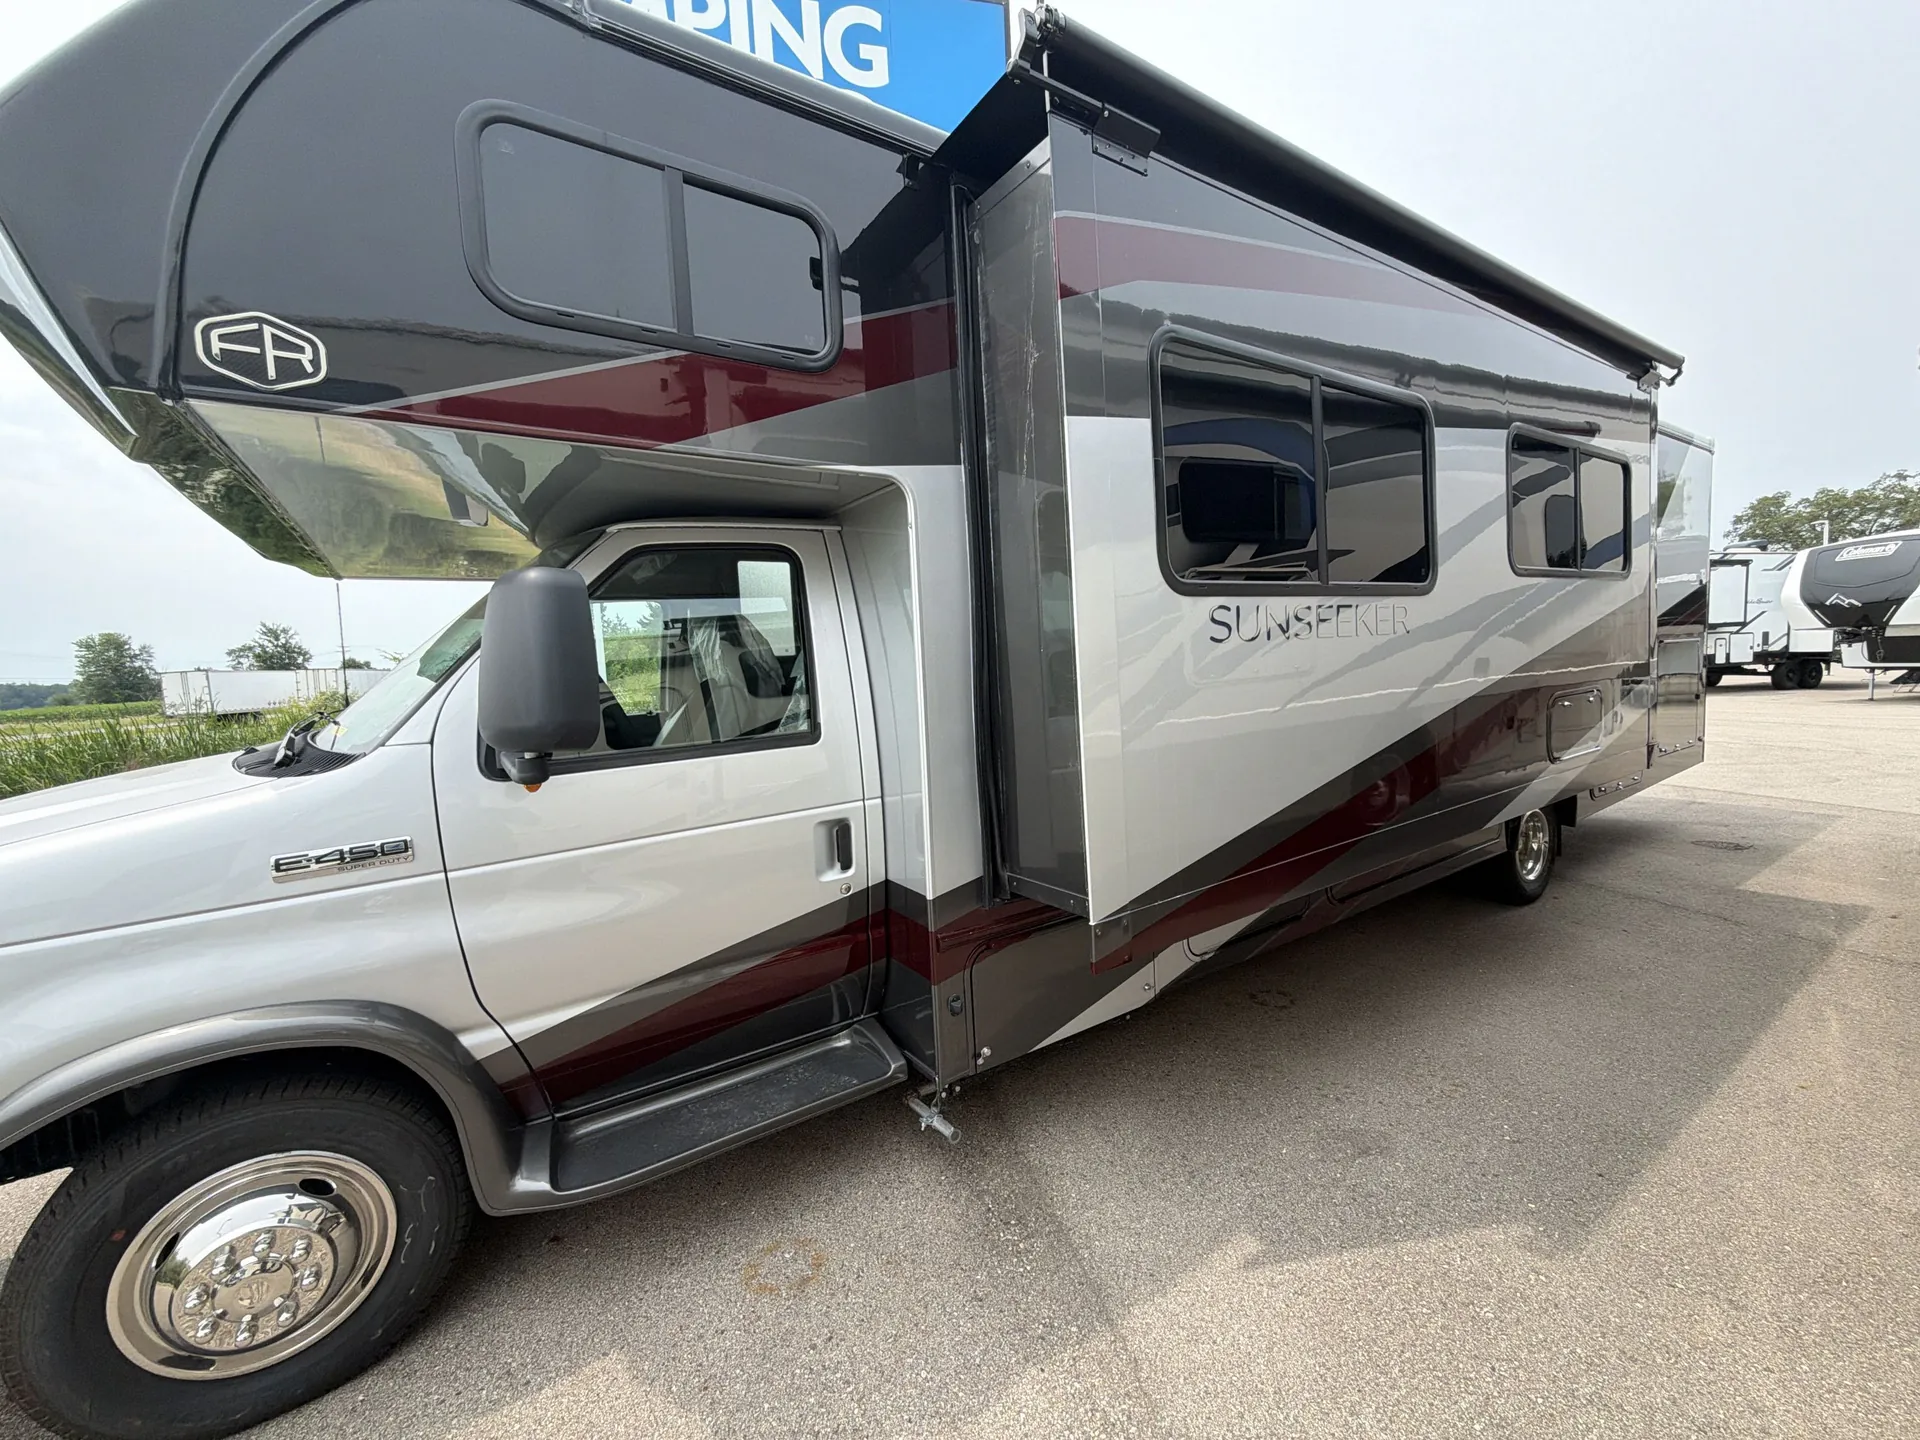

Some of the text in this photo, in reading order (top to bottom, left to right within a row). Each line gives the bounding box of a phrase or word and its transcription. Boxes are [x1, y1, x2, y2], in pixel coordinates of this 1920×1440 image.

[630, 0, 890, 88] PING
[1208, 604, 1411, 644] SUNSEEKER
[274, 838, 410, 873] E-450
[337, 856, 411, 872] SUPER DUTY
